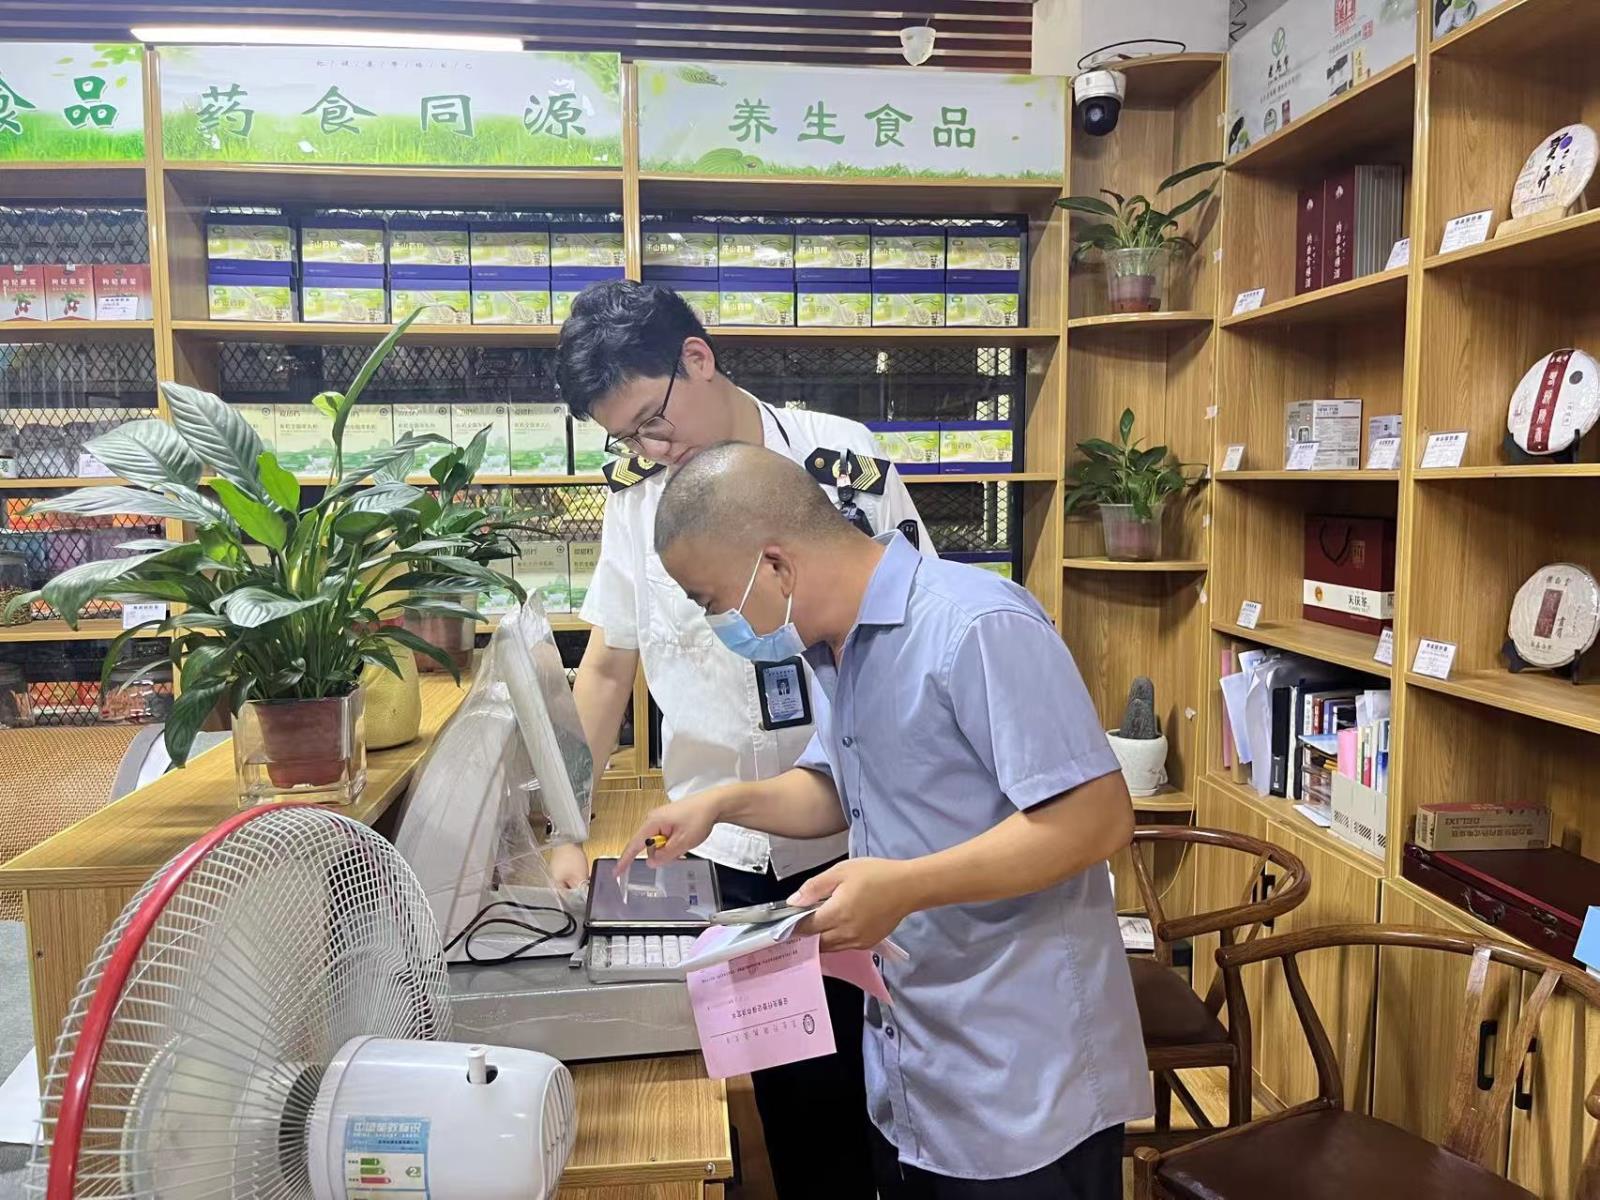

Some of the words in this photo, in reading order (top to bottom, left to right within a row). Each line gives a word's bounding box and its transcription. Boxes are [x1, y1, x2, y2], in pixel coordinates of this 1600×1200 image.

[195, 83, 587, 140] 药食同源
[728, 98, 977, 149] 养生食品
